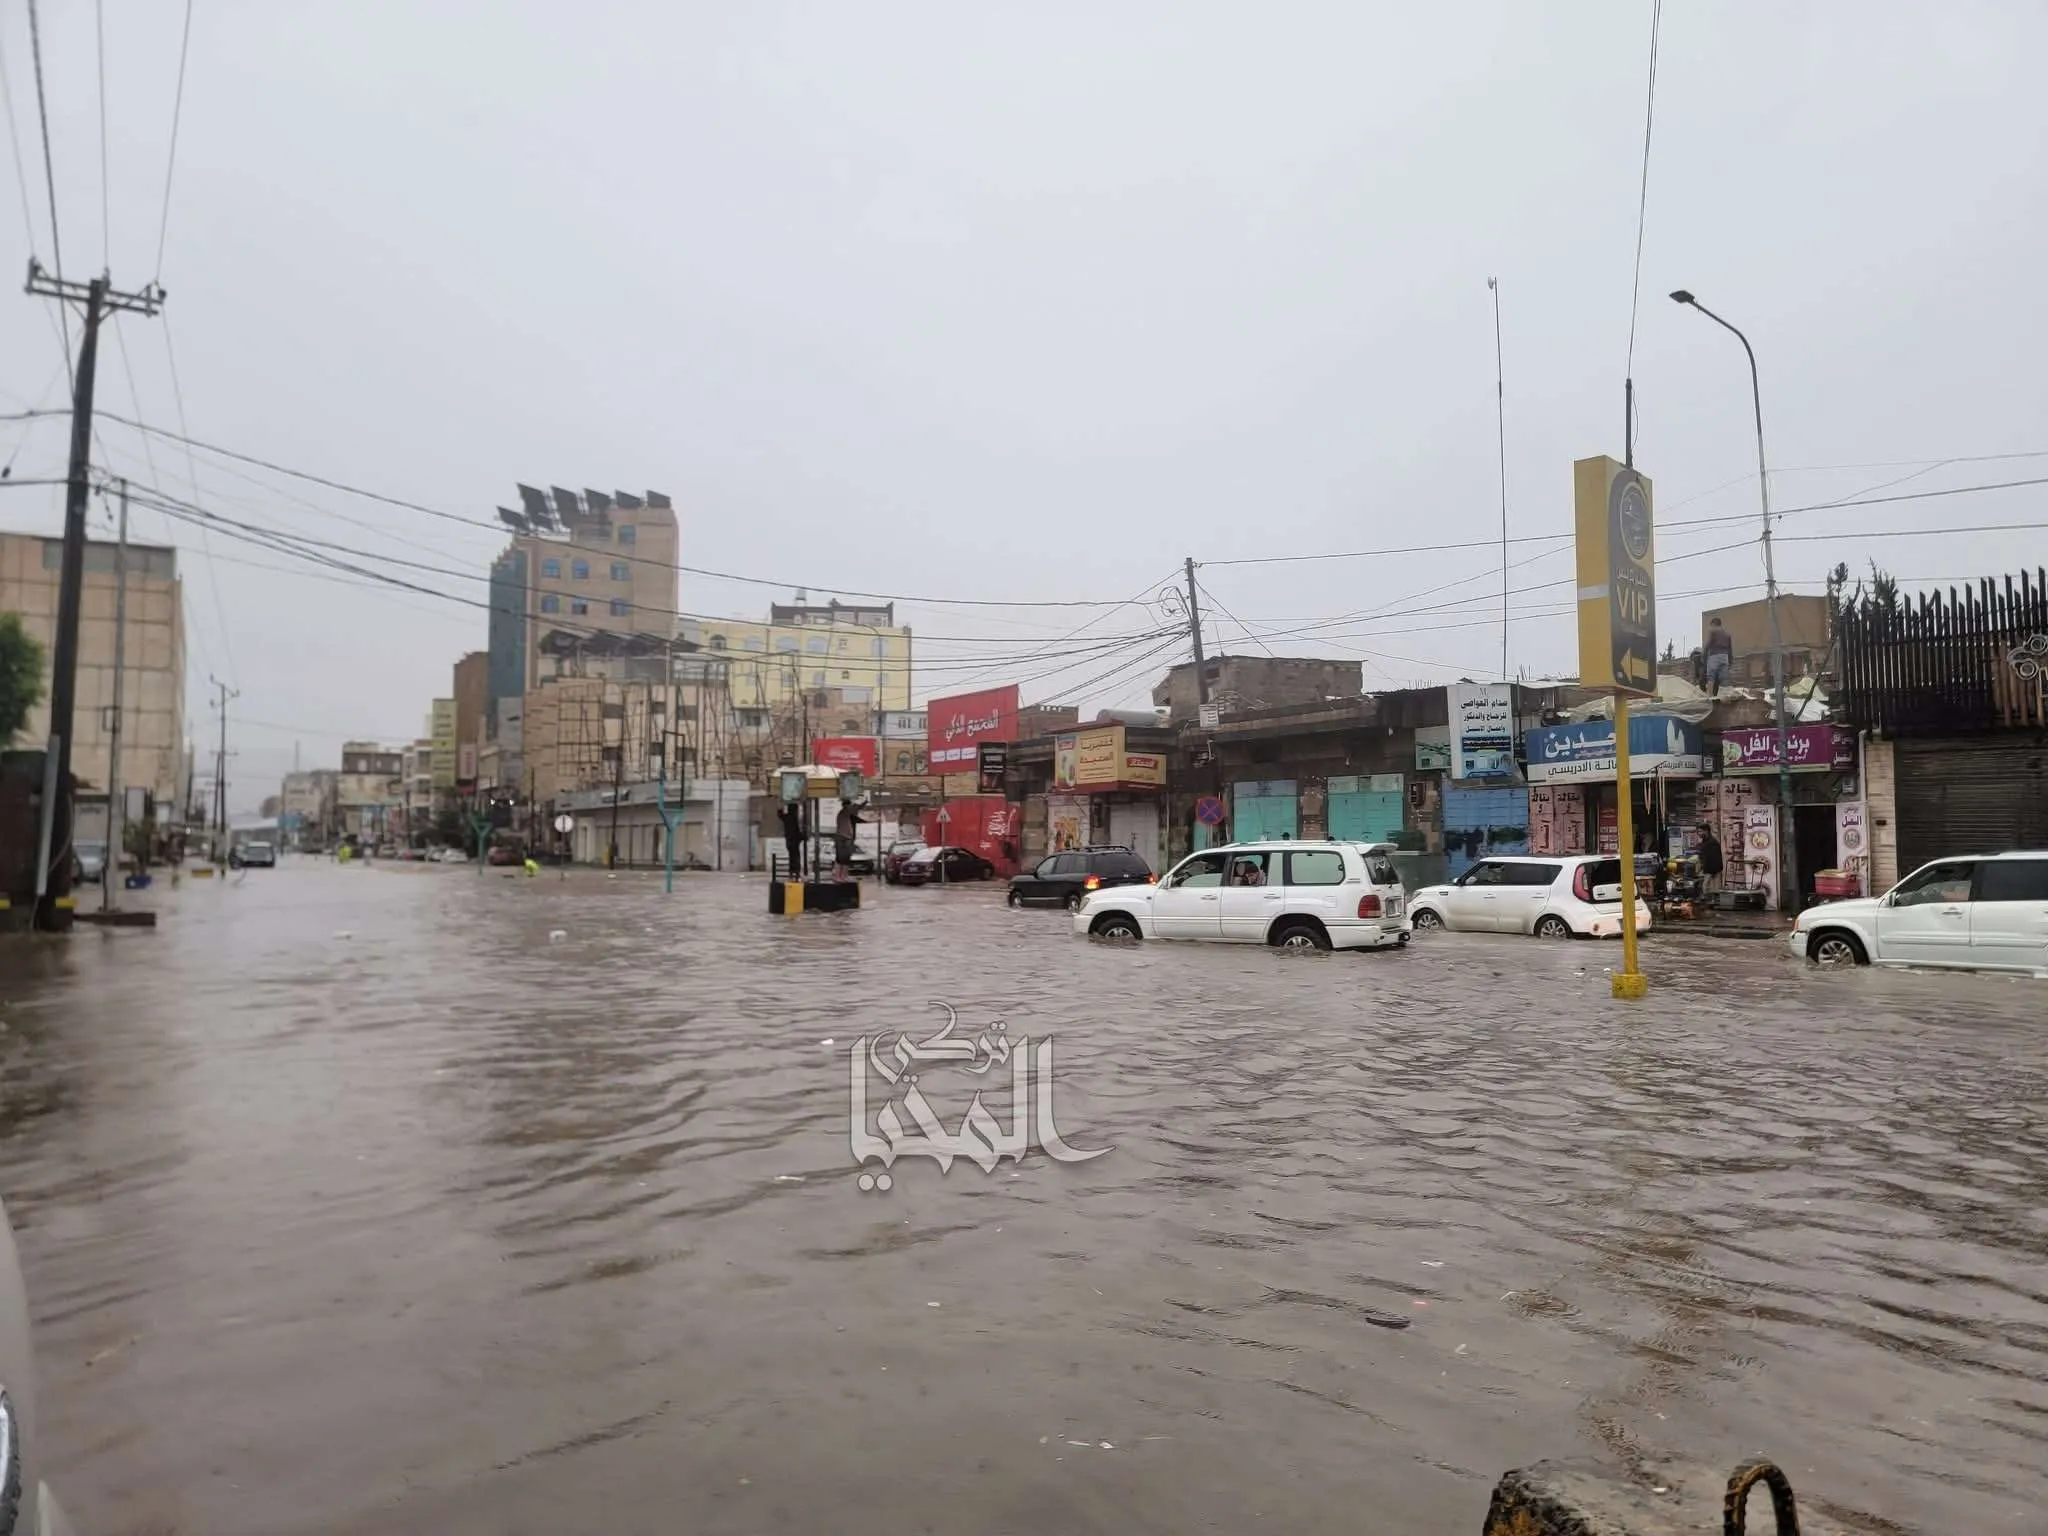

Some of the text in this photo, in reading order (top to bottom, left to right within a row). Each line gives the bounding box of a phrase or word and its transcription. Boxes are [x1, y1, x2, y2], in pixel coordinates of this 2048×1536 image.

[1616, 583, 1648, 624] VIP
[1743, 733, 1771, 756] الفل
[1595, 760, 1617, 771] الة
